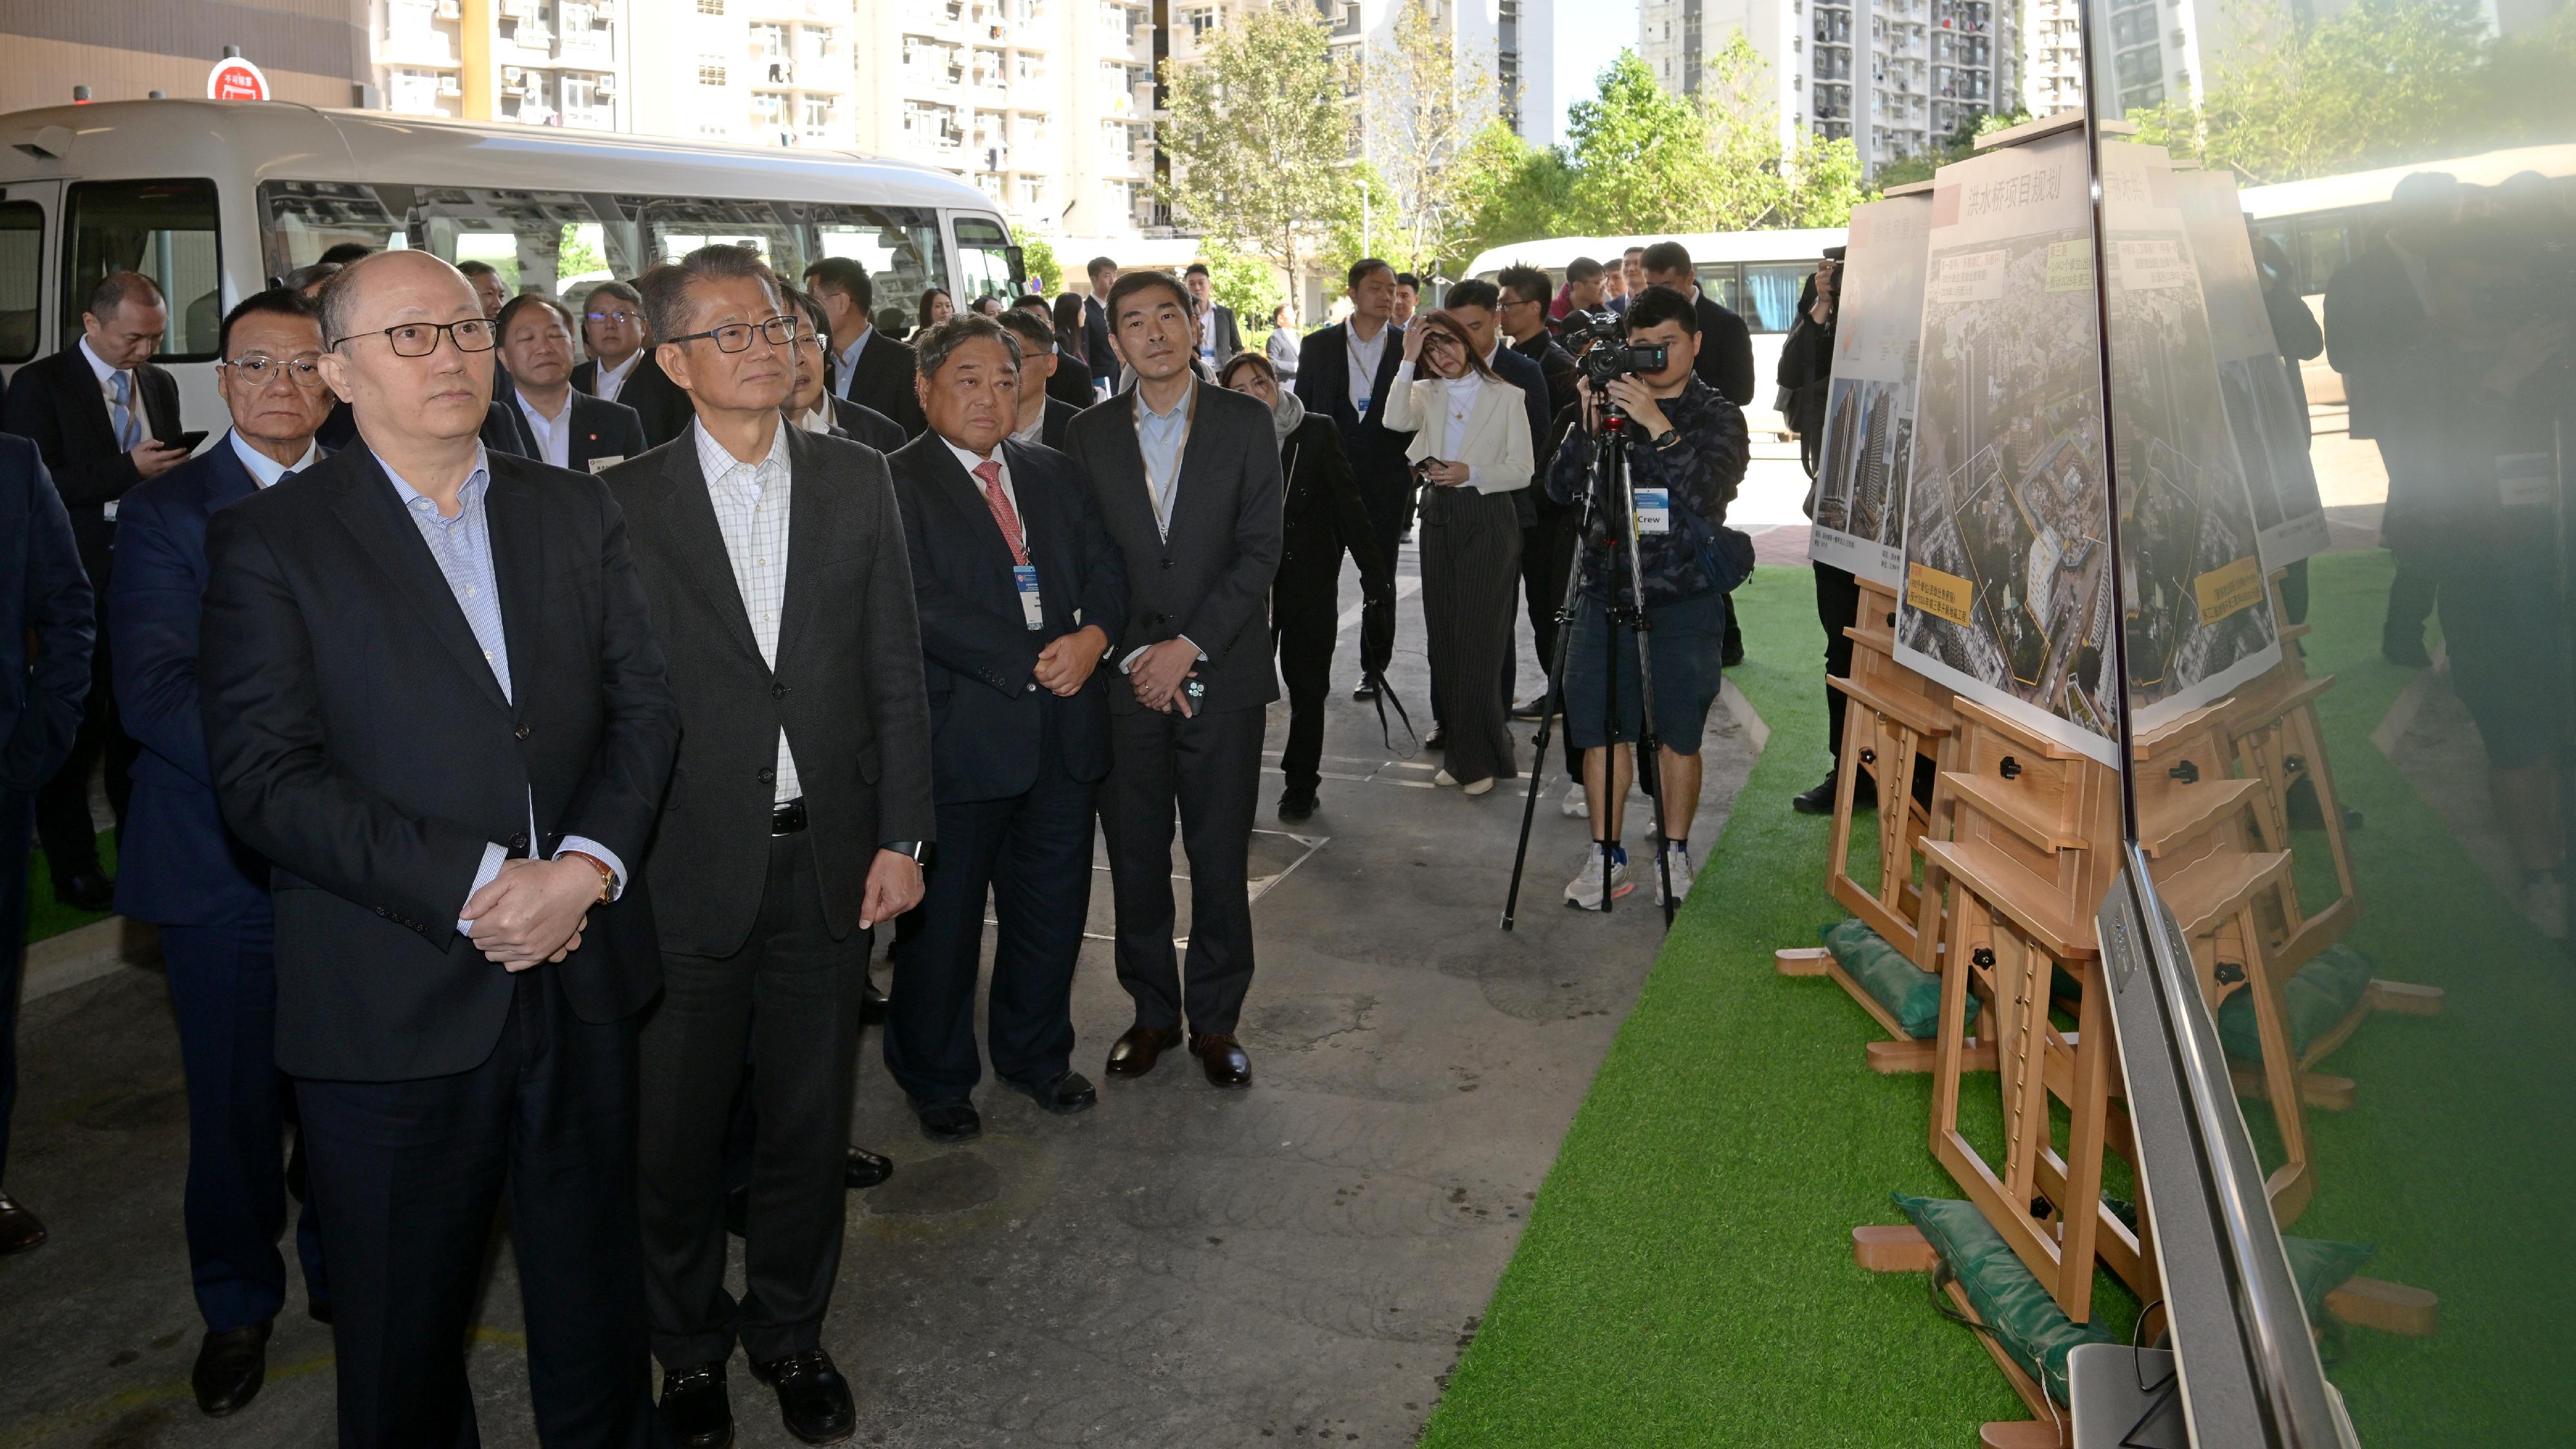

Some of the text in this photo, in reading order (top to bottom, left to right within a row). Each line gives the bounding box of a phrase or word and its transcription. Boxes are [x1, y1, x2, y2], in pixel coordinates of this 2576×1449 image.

[1967, 165, 2061, 216] 洪水桥项目规划
